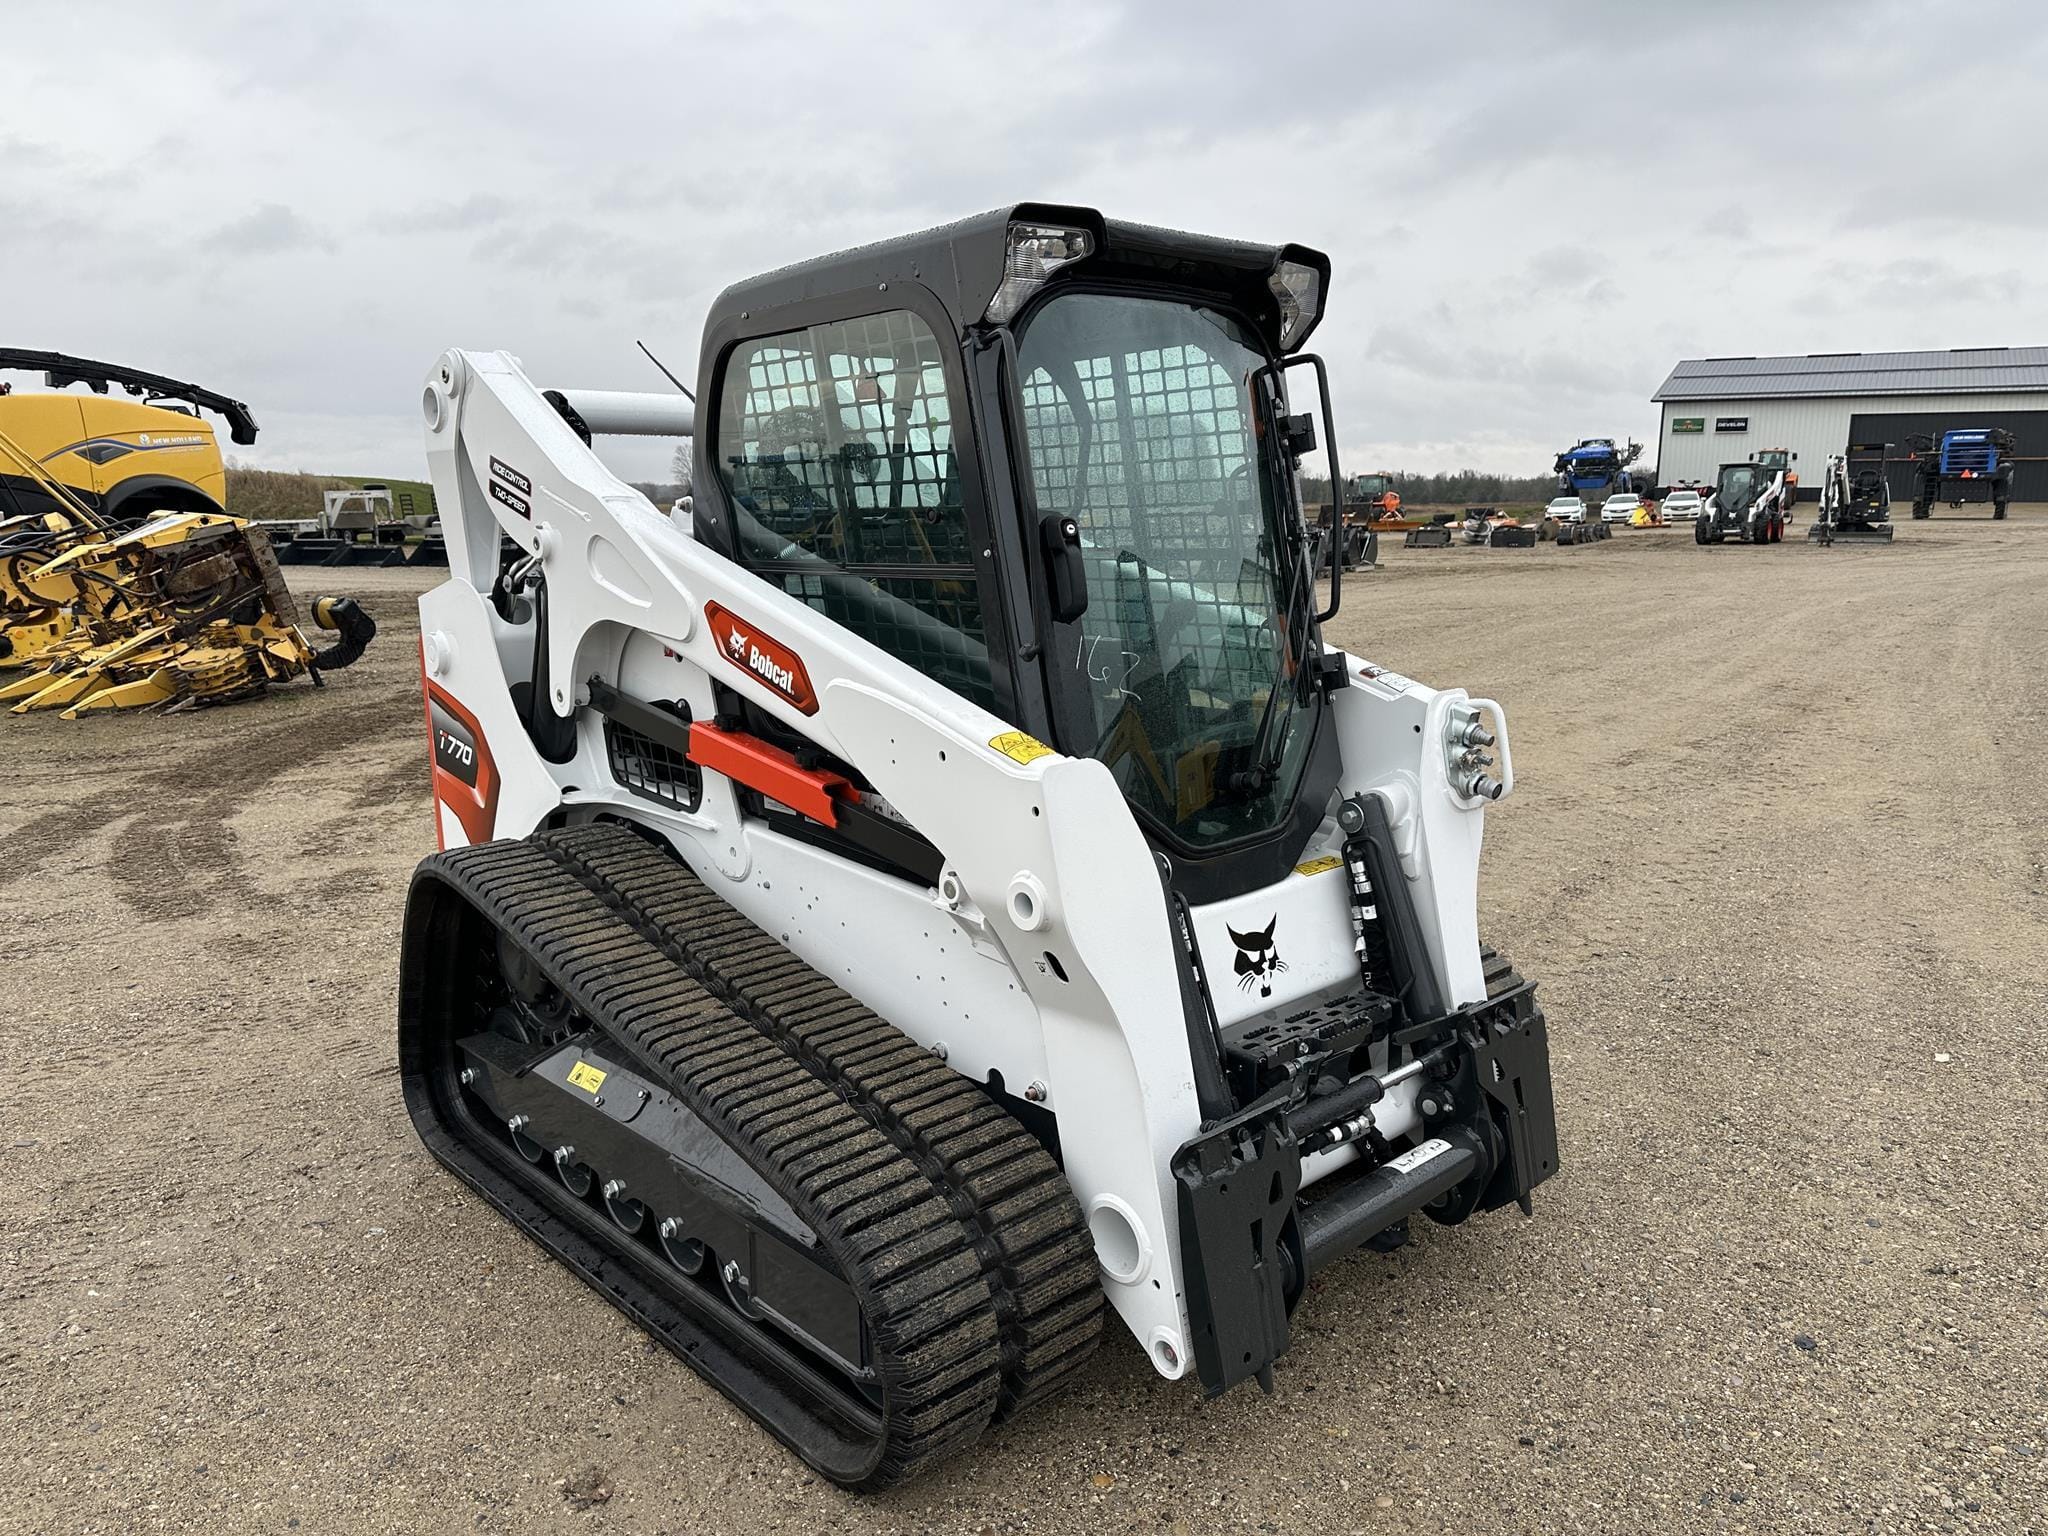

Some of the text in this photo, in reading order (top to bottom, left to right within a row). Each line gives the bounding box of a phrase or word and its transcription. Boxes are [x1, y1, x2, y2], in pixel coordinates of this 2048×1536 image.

[493, 462, 529, 491] RIDE CONTROL
[495, 486, 526, 513] TWO-SPEED
[749, 644, 794, 695] Bobcat
